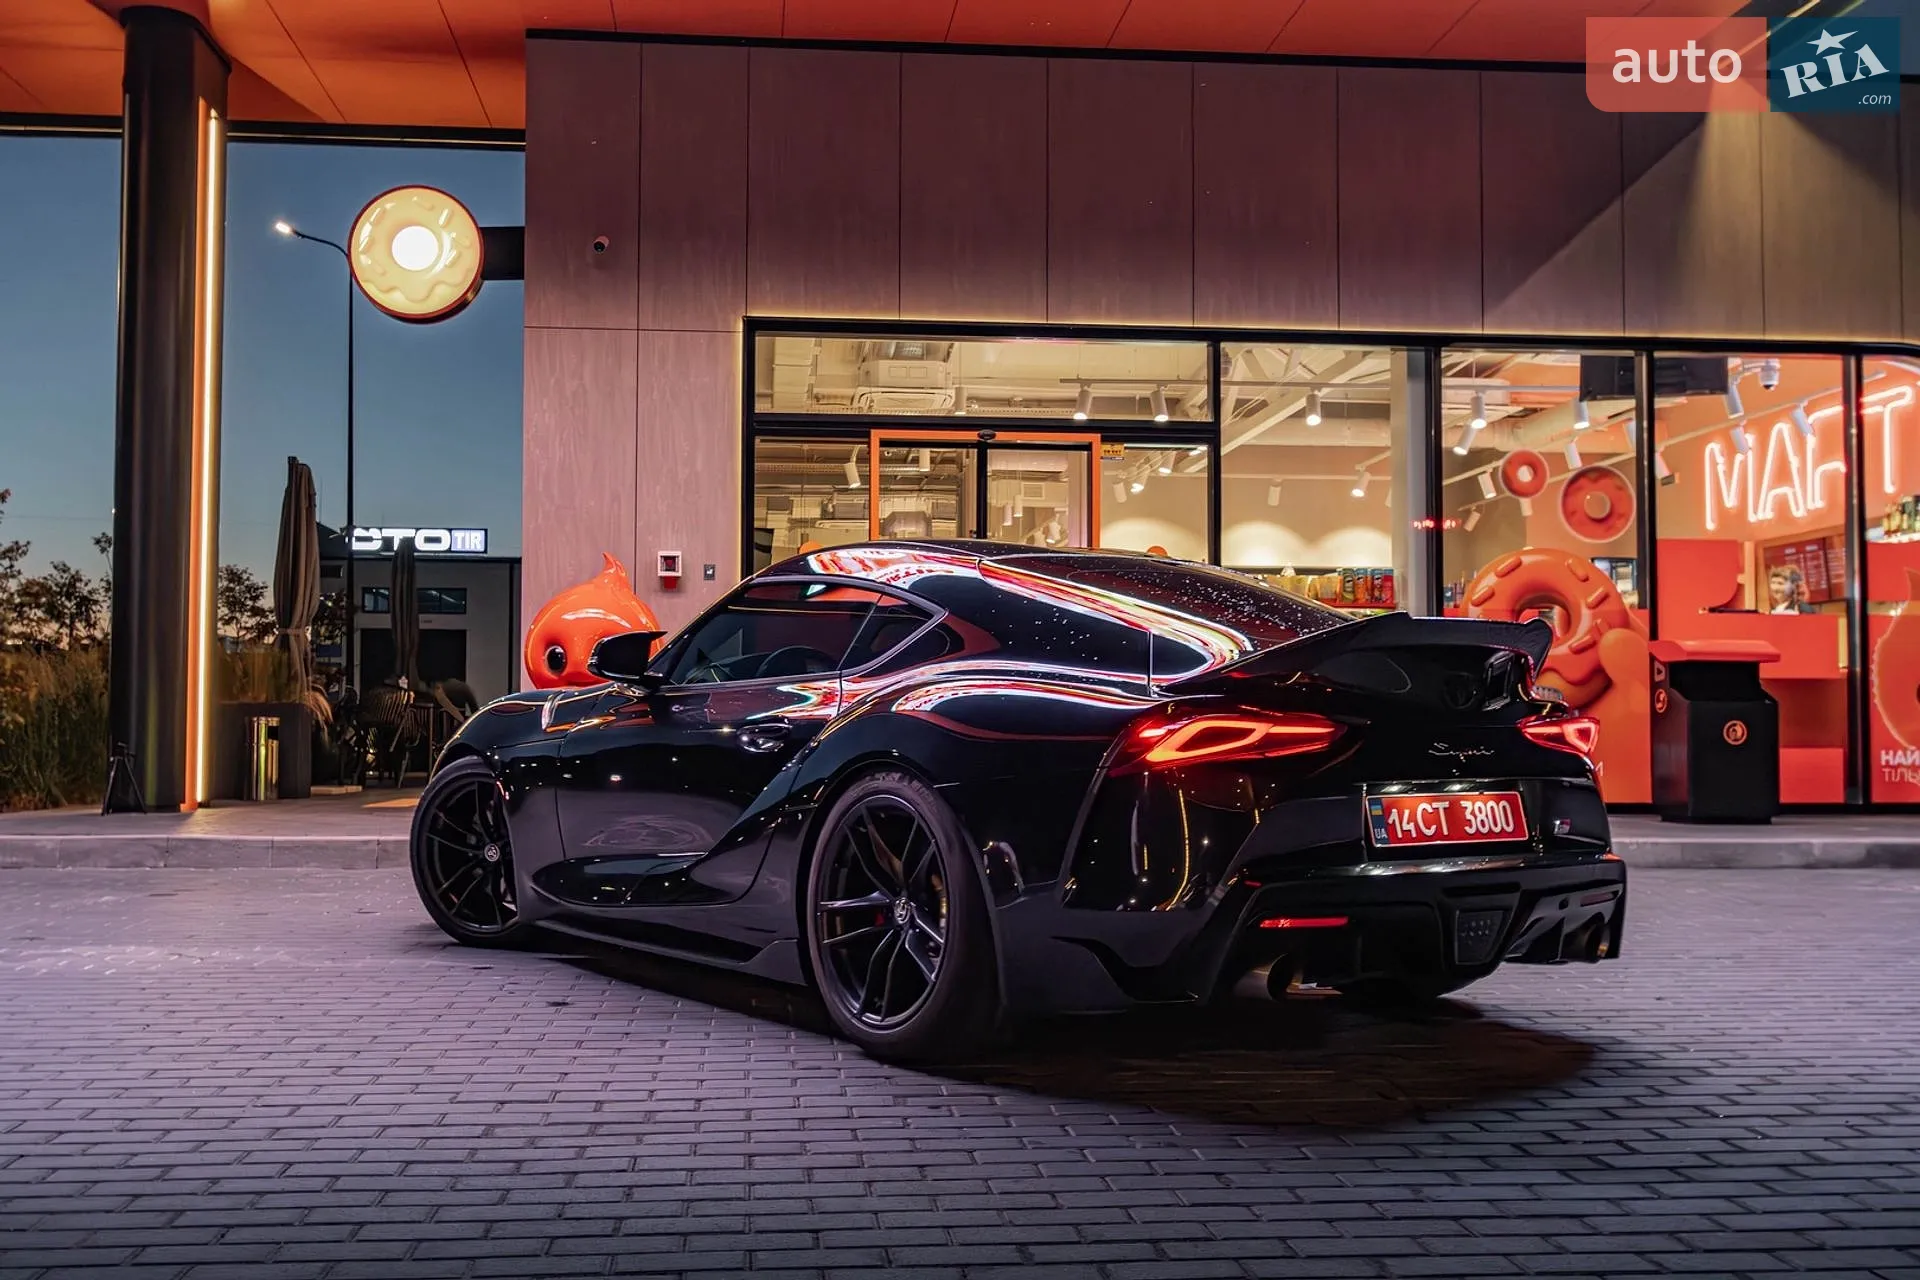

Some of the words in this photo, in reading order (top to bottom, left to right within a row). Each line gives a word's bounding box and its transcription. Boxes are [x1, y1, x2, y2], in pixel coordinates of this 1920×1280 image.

[453, 531, 482, 550] TIR
[1881, 767, 1920, 782] ТІЛЬ
[1460, 800, 1514, 835] 3800
[1374, 828, 1389, 840] UA
